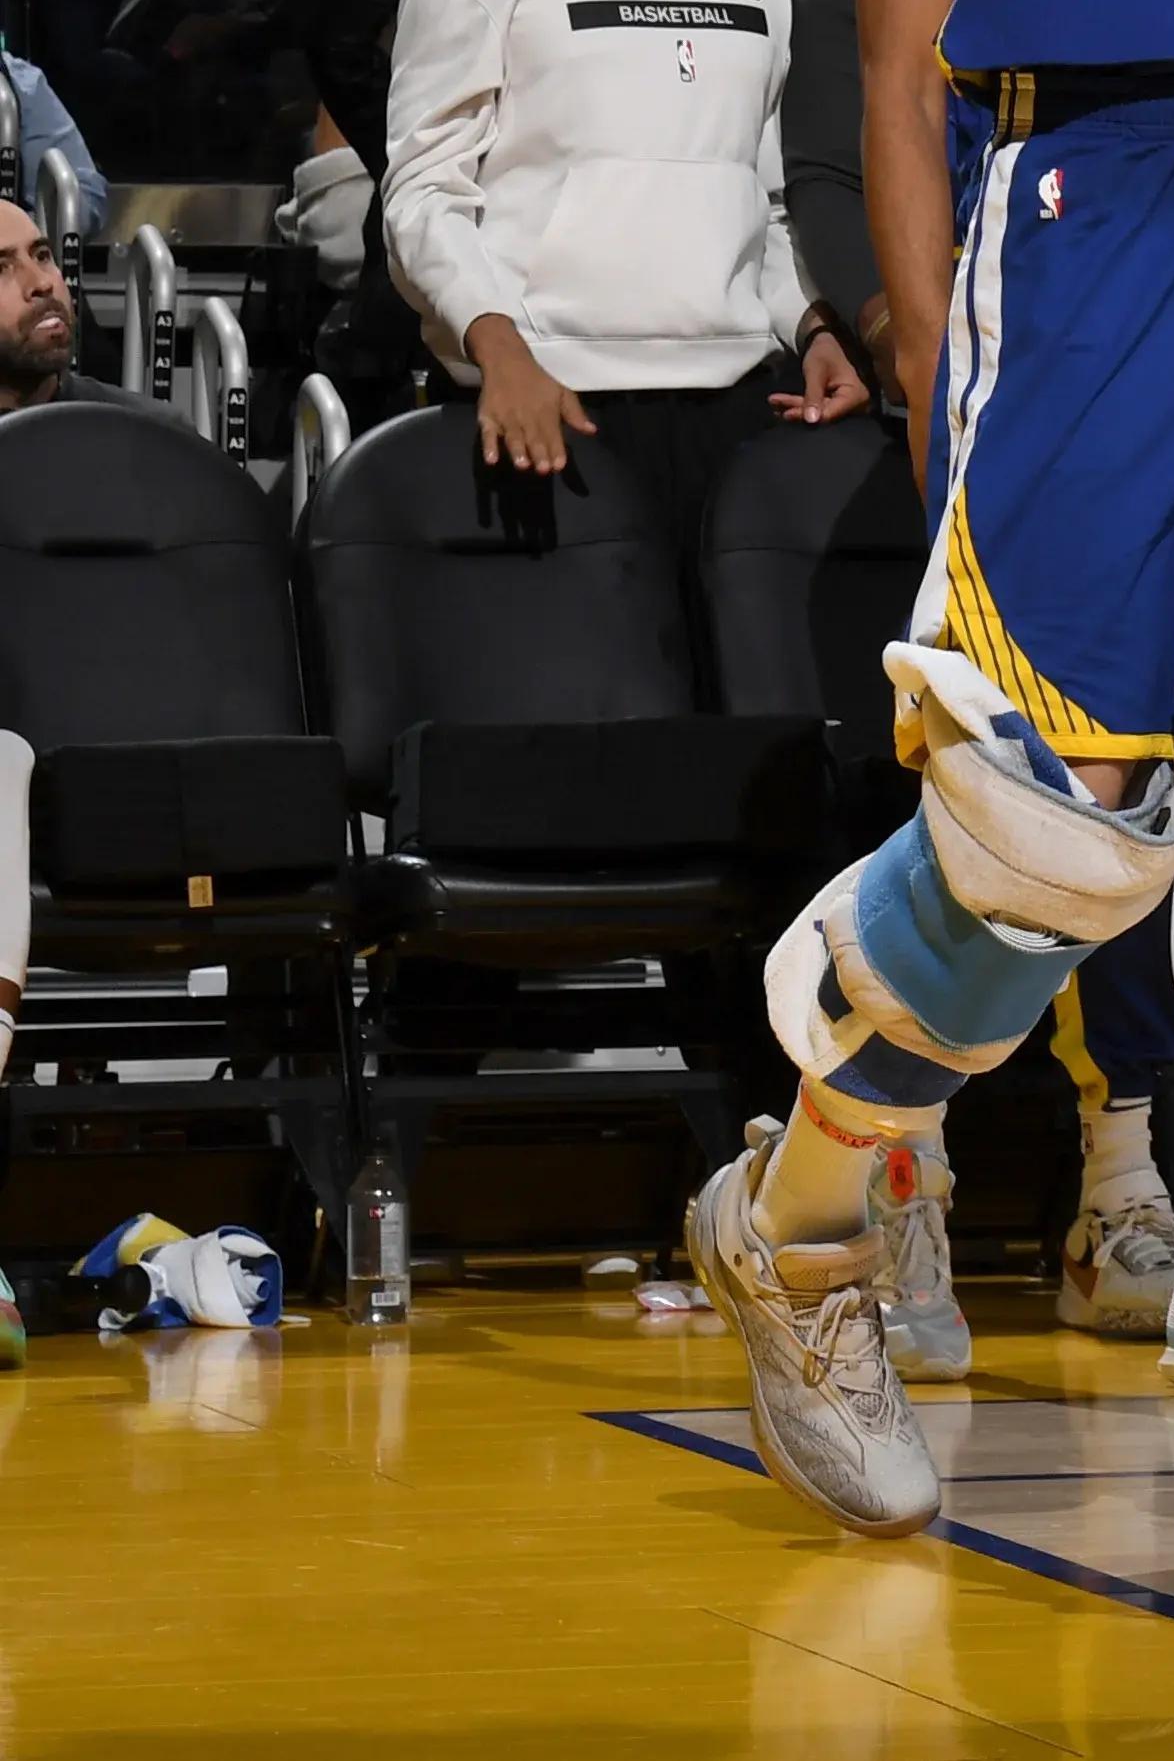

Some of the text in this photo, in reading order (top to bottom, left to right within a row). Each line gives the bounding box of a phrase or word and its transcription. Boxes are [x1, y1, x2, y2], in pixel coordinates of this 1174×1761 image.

[619, 5, 734, 25] BASKETBALL
[156, 315, 173, 327] A3
[155, 356, 171, 369] A3
[229, 393, 246, 406] A2
[228, 438, 245, 450] A2
